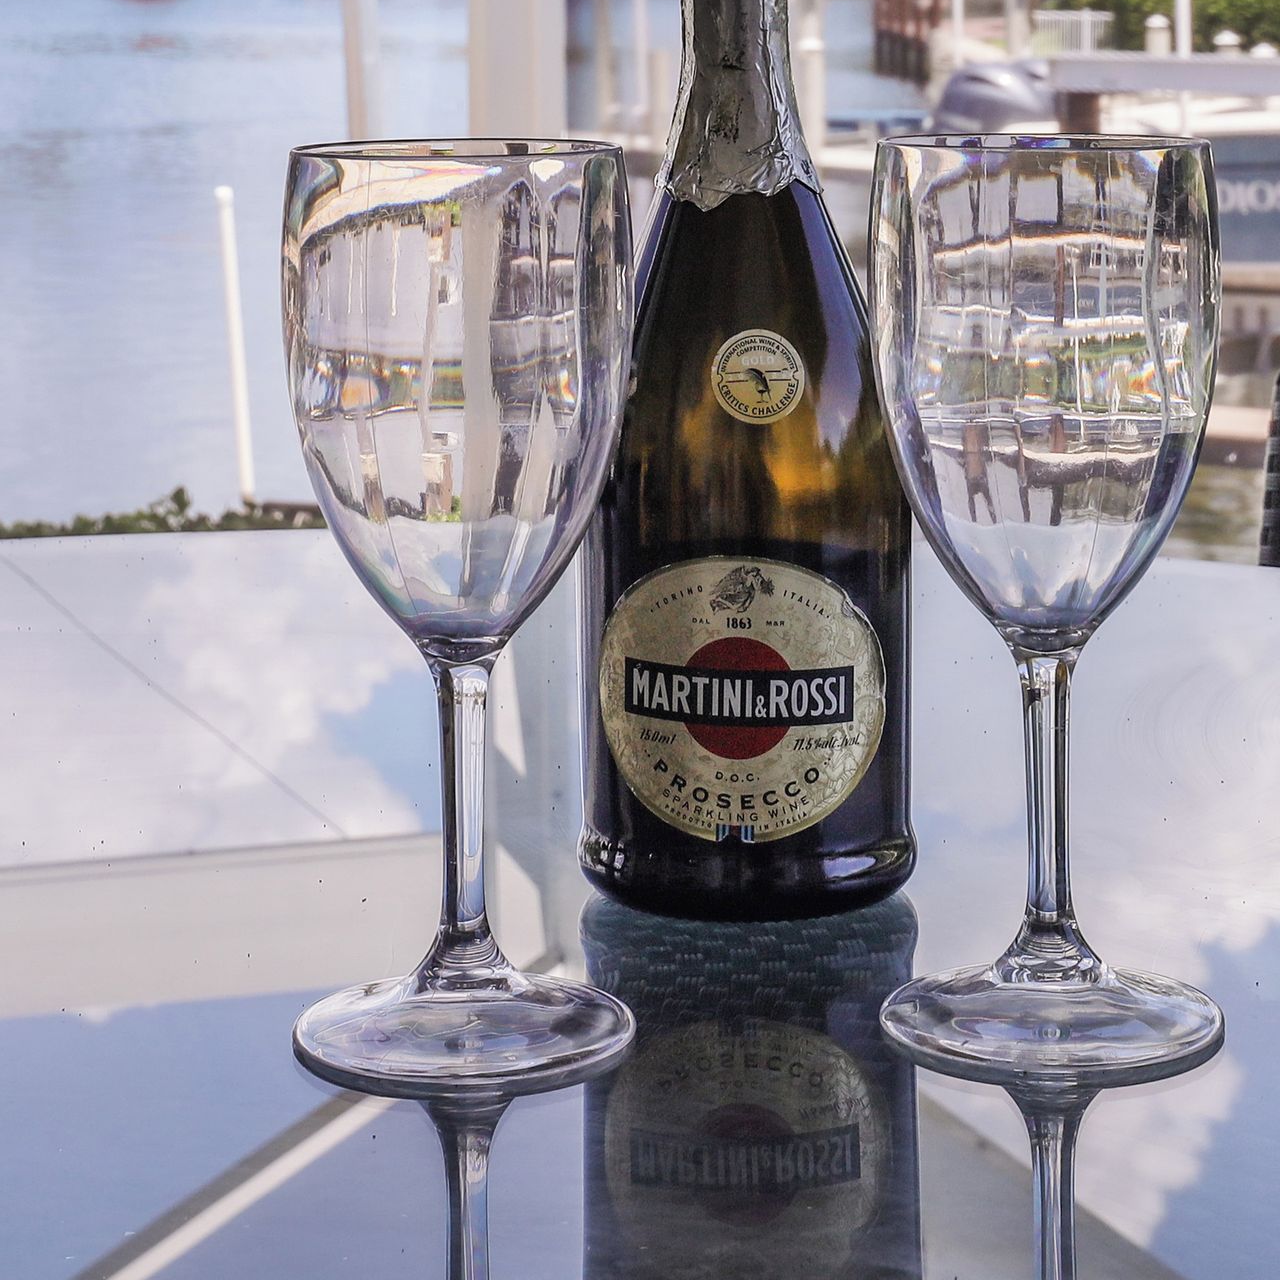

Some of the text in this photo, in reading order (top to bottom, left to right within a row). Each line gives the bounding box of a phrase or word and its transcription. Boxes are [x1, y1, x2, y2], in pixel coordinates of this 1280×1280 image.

[721, 338, 757, 372] INTERNATIONAL
[759, 338, 775, 348] WINE
[780, 348, 795, 370] SPIRITS
[736, 345, 777, 357] COMPETITION
[721, 382, 796, 415] CRITICS CHALLENGE
[726, 617, 752, 630] 1863
[653, 758, 820, 810] PROSECCO
[715, 771, 760, 783] D.O.C.
[662, 788, 809, 822] SPARKLING WINE
